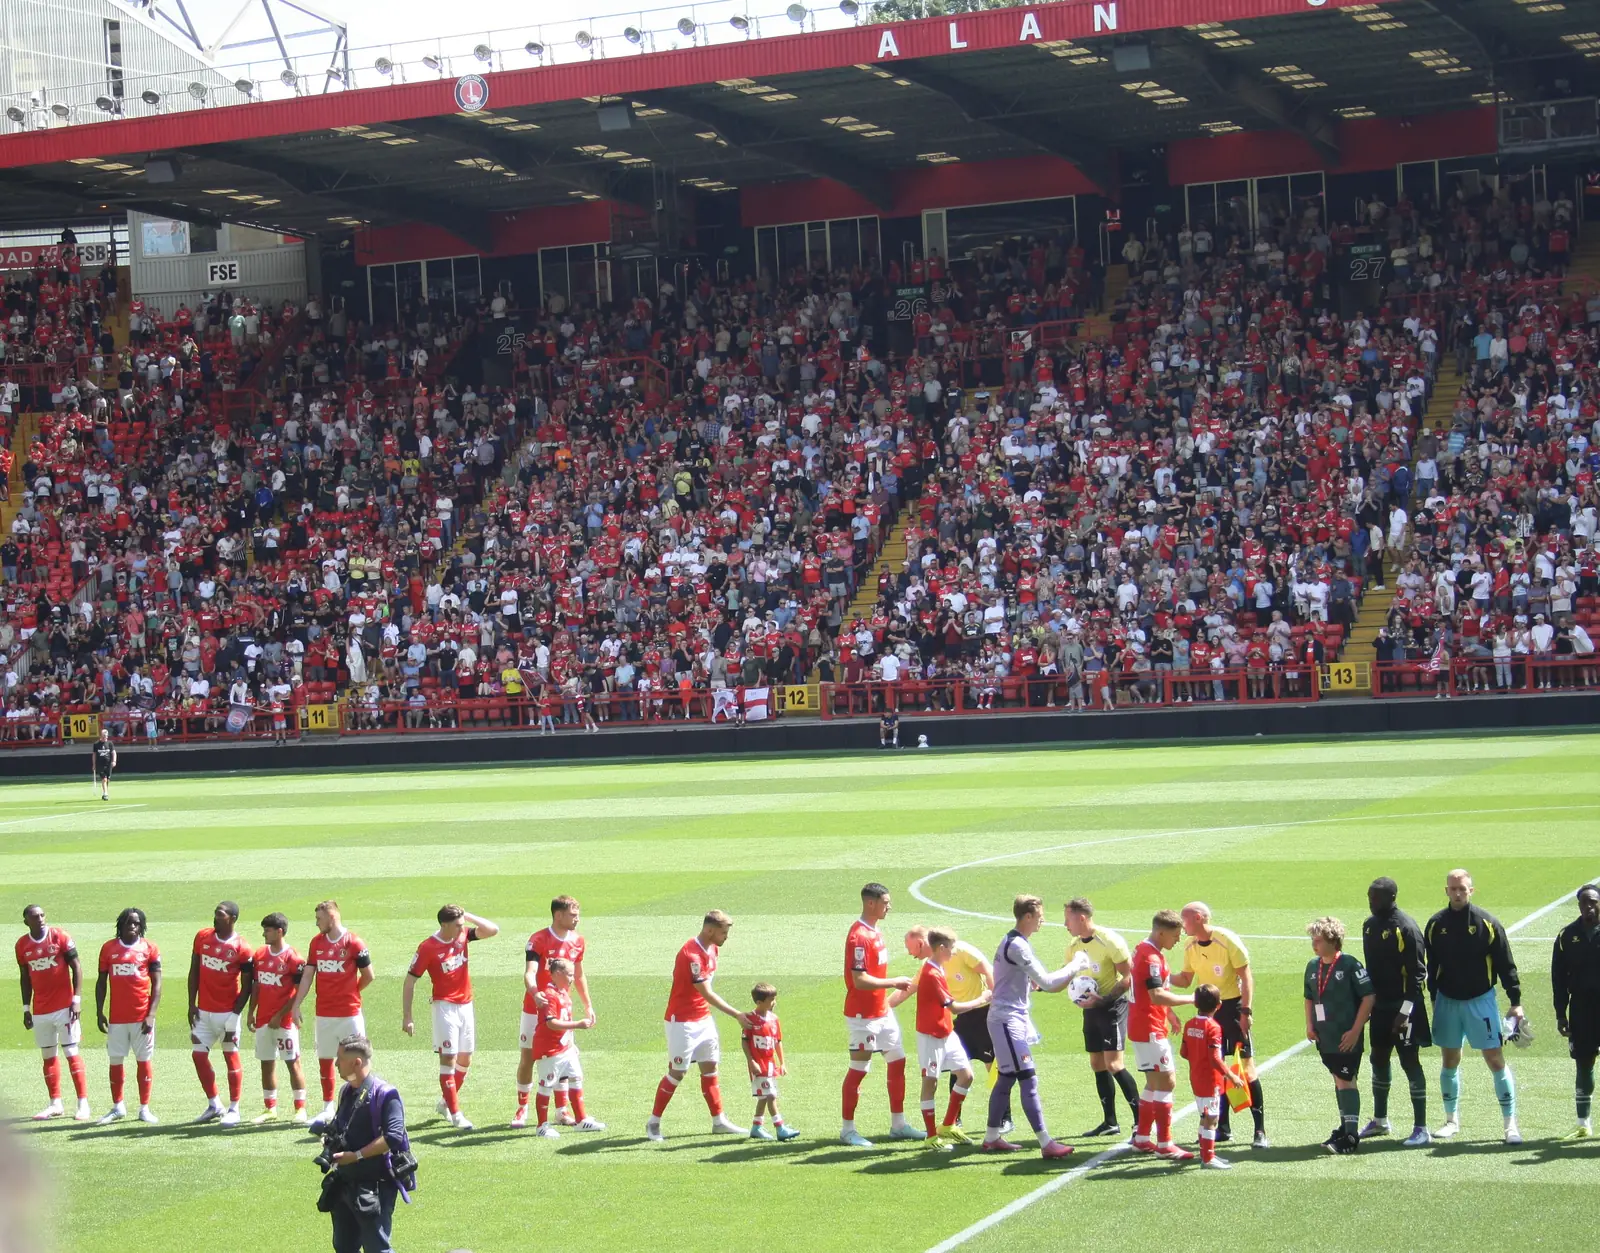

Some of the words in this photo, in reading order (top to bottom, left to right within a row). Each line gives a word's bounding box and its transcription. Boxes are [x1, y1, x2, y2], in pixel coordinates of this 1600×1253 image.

[877, 3, 1117, 58] ALAN
[76, 245, 106, 261] FSB
[210, 263, 238, 281] FSE
[1350, 256, 1386, 280] 27
[496, 333, 527, 354] 25
[1334, 668, 1353, 685] 13
[788, 690, 805, 705] 12
[312, 710, 325, 724] 11
[73, 719, 87, 733] 10
[28, 955, 59, 971] RSK
[112, 963, 142, 976] RSK
[202, 953, 231, 972] RSK
[317, 959, 346, 973] RSK
[258, 970, 283, 987] RSK
[1483, 1017, 1492, 1033] 1
[276, 1038, 293, 1051] 30
